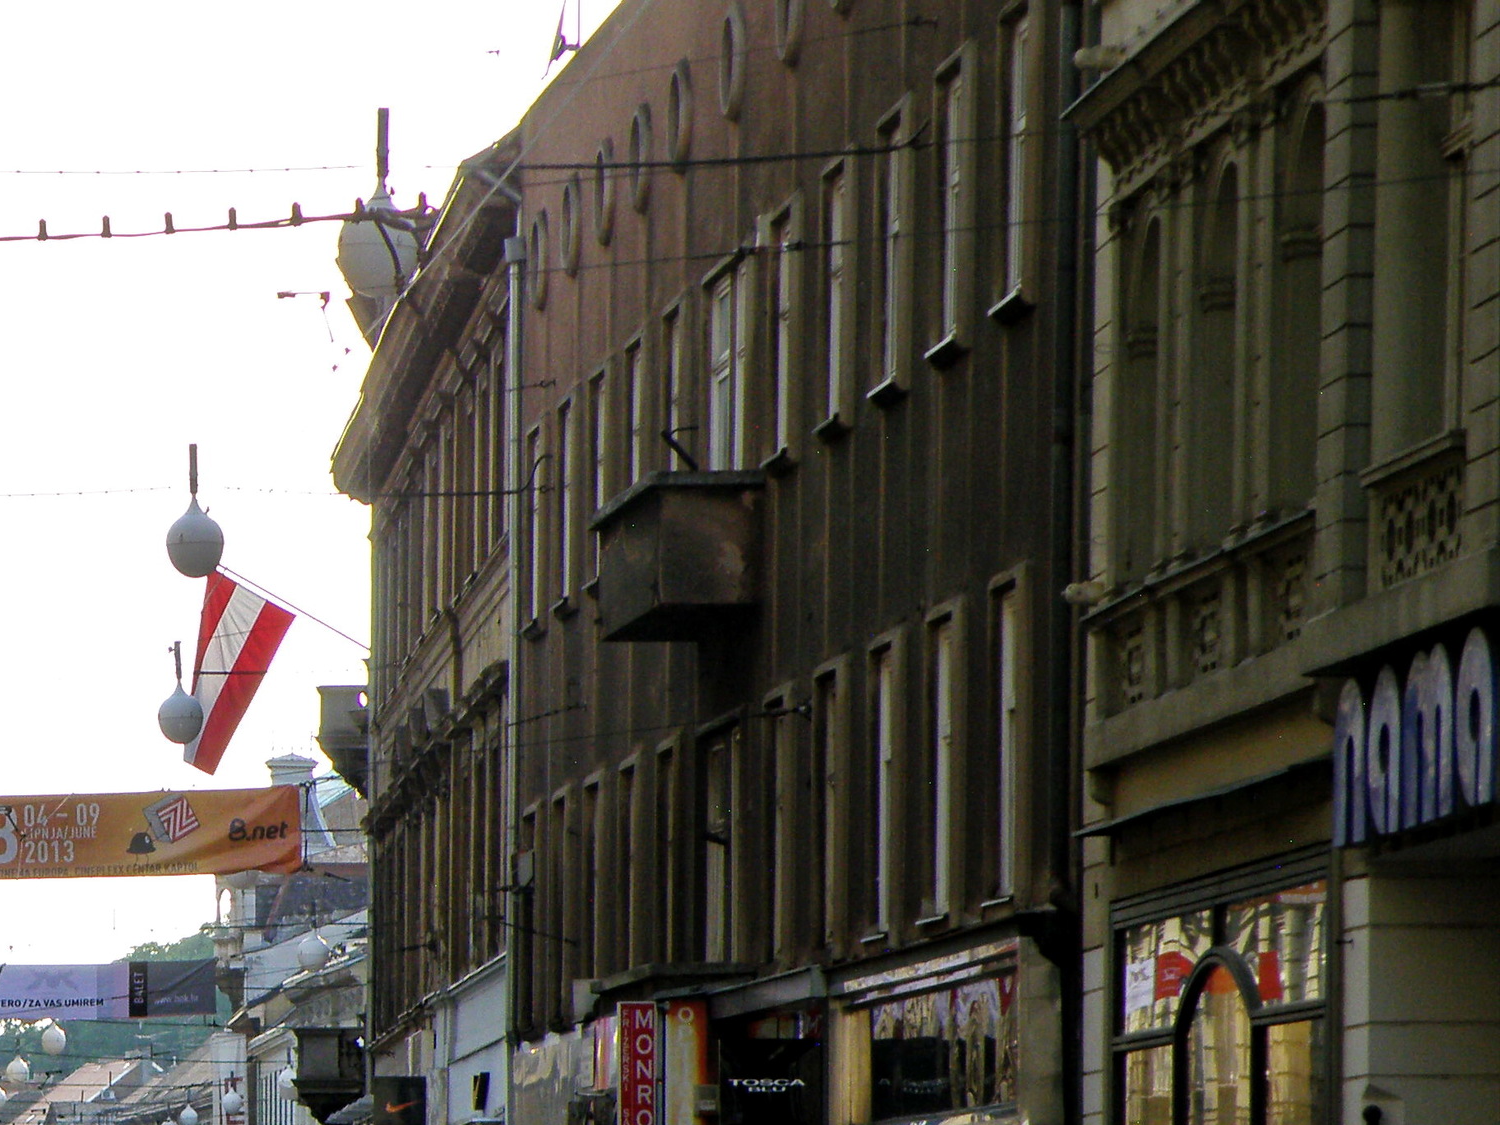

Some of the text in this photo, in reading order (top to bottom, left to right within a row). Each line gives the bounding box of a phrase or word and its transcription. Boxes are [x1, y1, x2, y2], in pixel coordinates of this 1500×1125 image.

[1332, 626, 1492, 848] nama
[23, 803, 48, 827] 04
[75, 802, 100, 826] 09
[24, 841, 75, 864] 2013
[43, 998, 63, 1007] VAS
[64, 998, 104, 1007] UMIREM
[621, 1009, 631, 1092] FRIZERSKI
[728, 1078, 805, 1086] TOSCA
